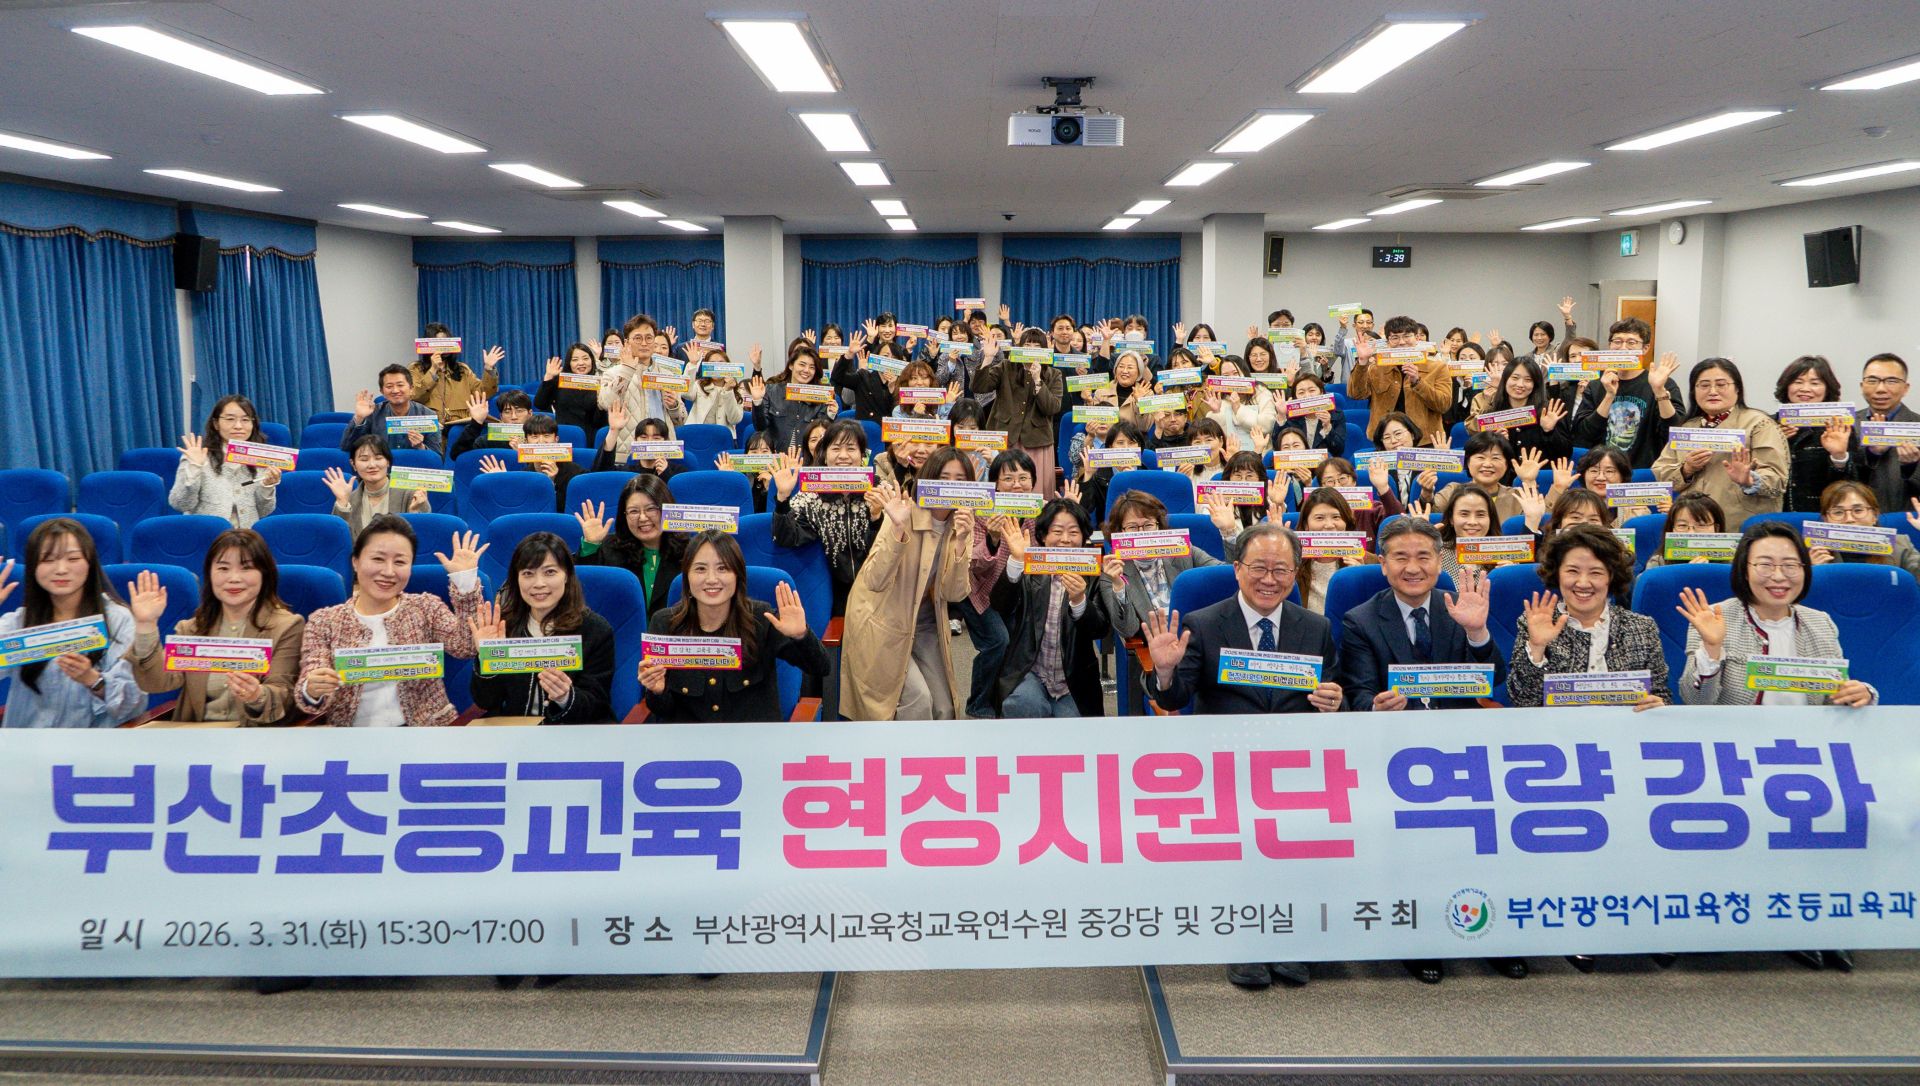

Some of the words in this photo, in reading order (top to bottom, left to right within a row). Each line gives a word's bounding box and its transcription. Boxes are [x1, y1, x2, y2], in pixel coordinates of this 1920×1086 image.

[1384, 254, 1405, 263] 3:39
[491, 648, 505, 657] 나는
[535, 659, 575, 668] 되겠습니다!
[1230, 659, 1245, 668] 나는
[1273, 676, 1313, 687] 되겠습니다!
[1399, 673, 1413, 681] 나는
[47, 761, 742, 874] 부산초등교육
[783, 750, 1358, 868] 현장지원단
[1387, 745, 1615, 854] 역량
[1640, 740, 1877, 851] 강화
[1507, 891, 1751, 930] 부산광역시교육청
[1767, 891, 1917, 922] 초등교육과
[693, 908, 1067, 946] 부산광역시교육청교육연수원
[1078, 906, 1163, 938] 중강당
[1175, 905, 1199, 936] 및
[1211, 904, 1294, 936] 강의실
[164, 921, 239, 947] 2026.
[283, 919, 367, 949] 31.(화)
[378, 919, 544, 944] 15:30~17:00
